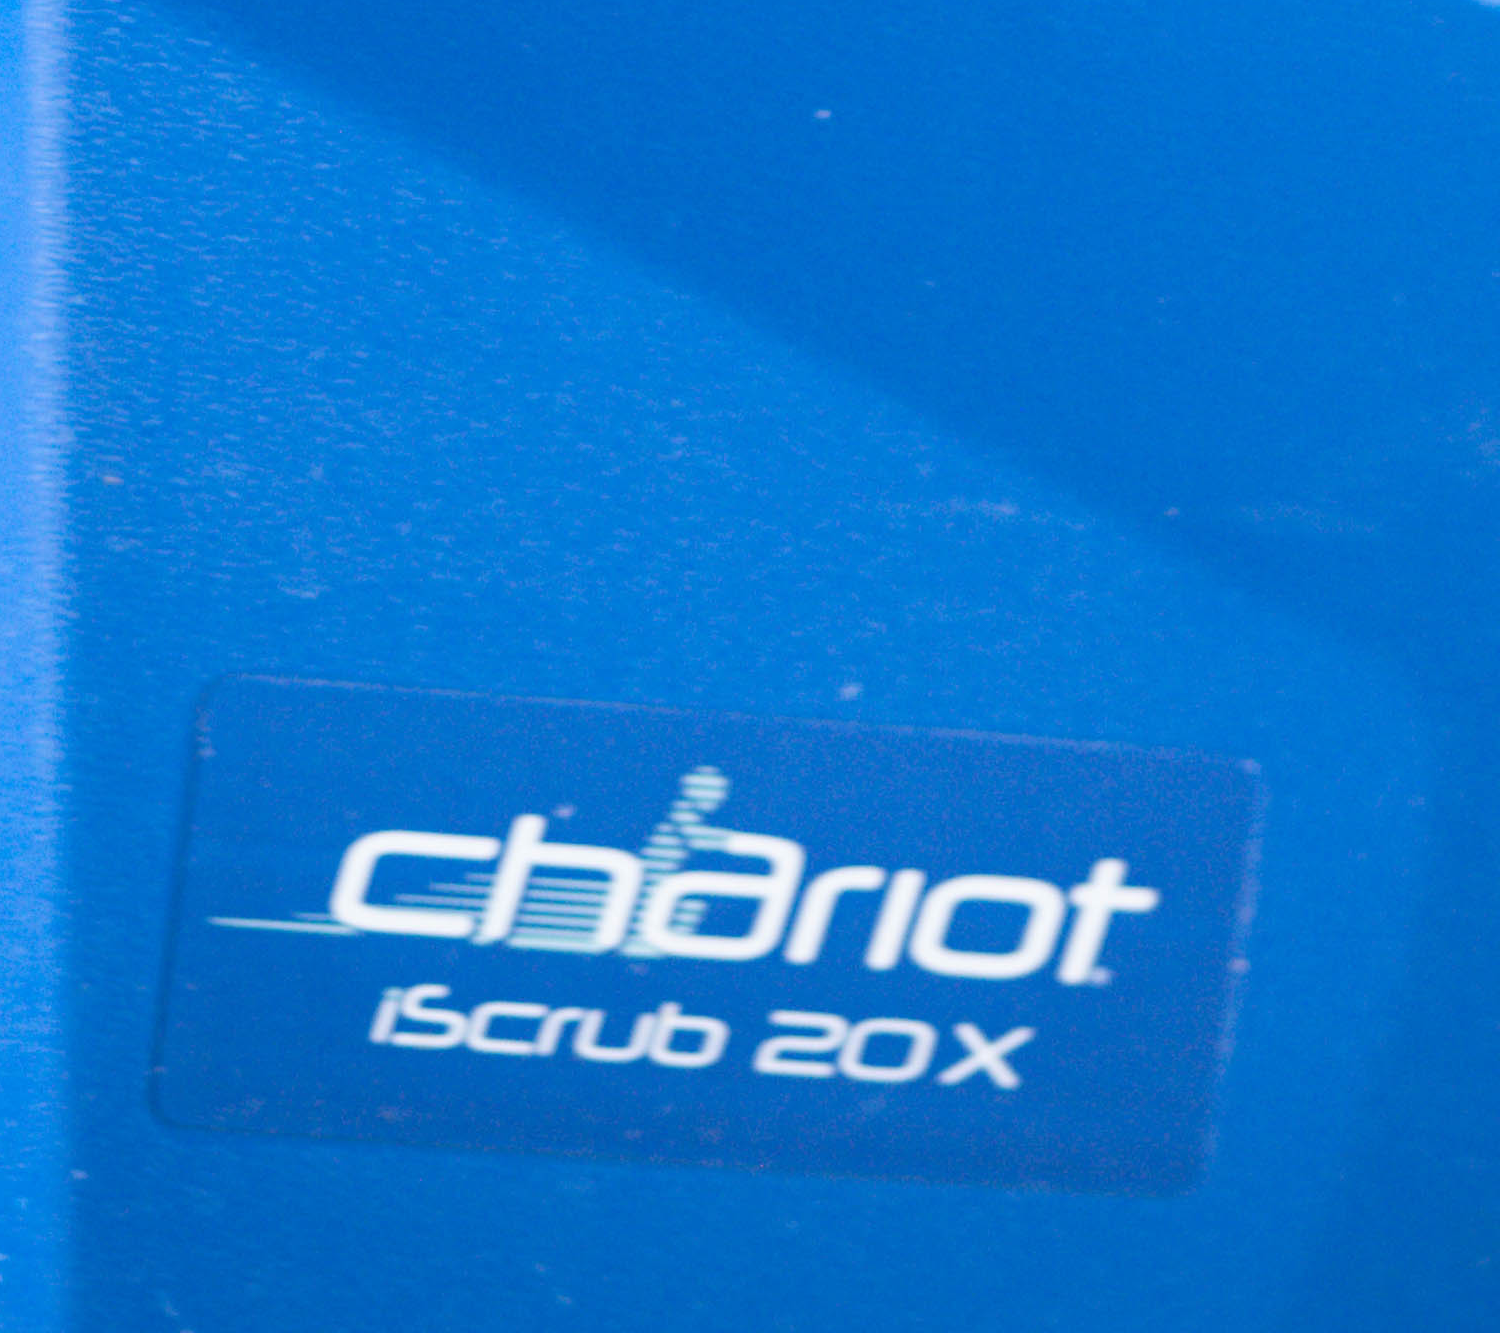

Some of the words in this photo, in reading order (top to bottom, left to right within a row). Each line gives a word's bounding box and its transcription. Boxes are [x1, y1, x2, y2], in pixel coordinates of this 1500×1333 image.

[328, 813, 1160, 986] chariot
[369, 983, 731, 1069] iScrub
[752, 1009, 1034, 1090] 20X
